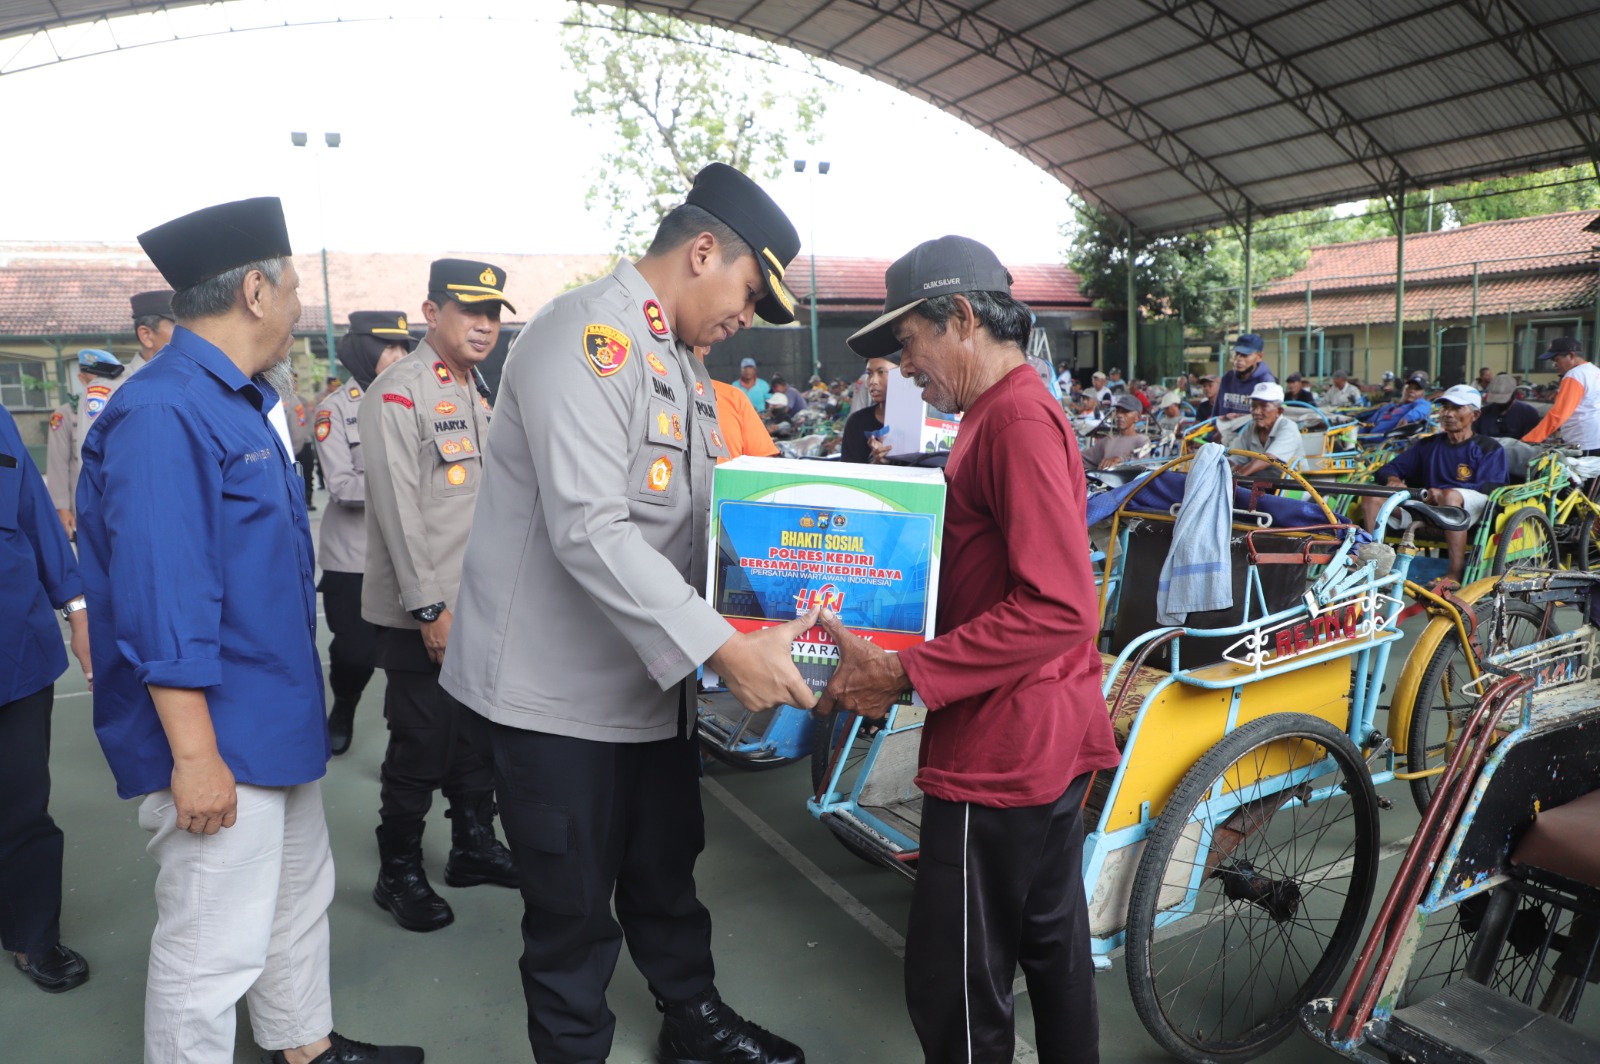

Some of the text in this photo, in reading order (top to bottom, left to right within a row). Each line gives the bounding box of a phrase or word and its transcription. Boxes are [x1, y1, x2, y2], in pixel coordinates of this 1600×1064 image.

[652, 376, 676, 403] BIMO
[781, 530, 865, 552] BHAKTI SOSIAL
[769, 547, 874, 566] POLRES KEDIRI
[740, 557, 903, 580] BERSAMA PWI KEDIRI RAYA
[750, 569, 892, 587] (PERSATUAN WARTAWAN INDONESIA)
[1275, 605, 1357, 658] RETNO
[812, 678, 828, 687] lahi
